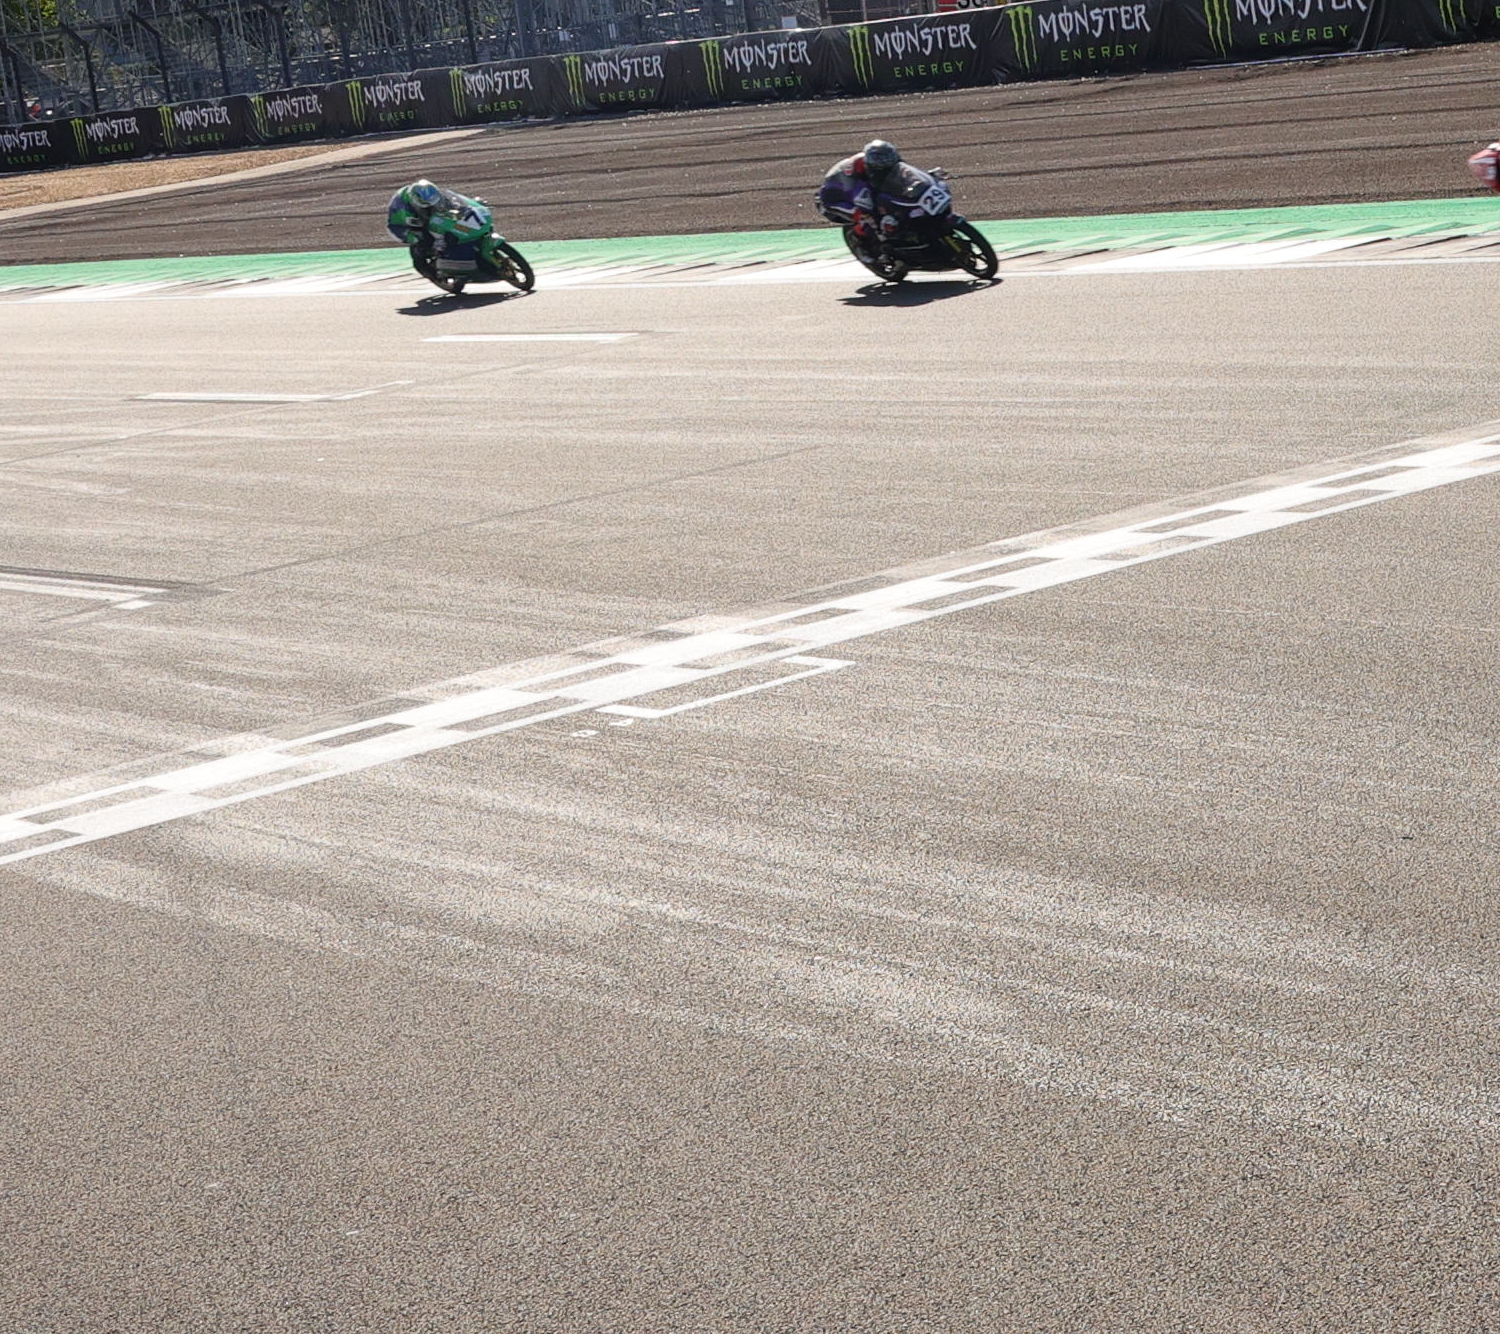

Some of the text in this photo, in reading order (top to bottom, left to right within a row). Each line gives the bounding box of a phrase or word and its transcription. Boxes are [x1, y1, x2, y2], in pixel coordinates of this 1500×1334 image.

[1038, 3, 1152, 43] MONSTER
[1258, 24, 1350, 46] ENERGY
[874, 23, 977, 60] MONSTER
[1060, 43, 1138, 62] ENERGY
[723, 38, 812, 73] MONSTER
[464, 67, 534, 98] MONSTER
[584, 54, 665, 87] MONSTER
[741, 75, 804, 90] ENERGY
[894, 60, 965, 79] ENERGY
[364, 79, 425, 108] MONSTER
[174, 105, 231, 131] MONSTER
[266, 94, 322, 122] MONSTER
[85, 116, 140, 142] MONSTER
[923, 188, 947, 211] 29
